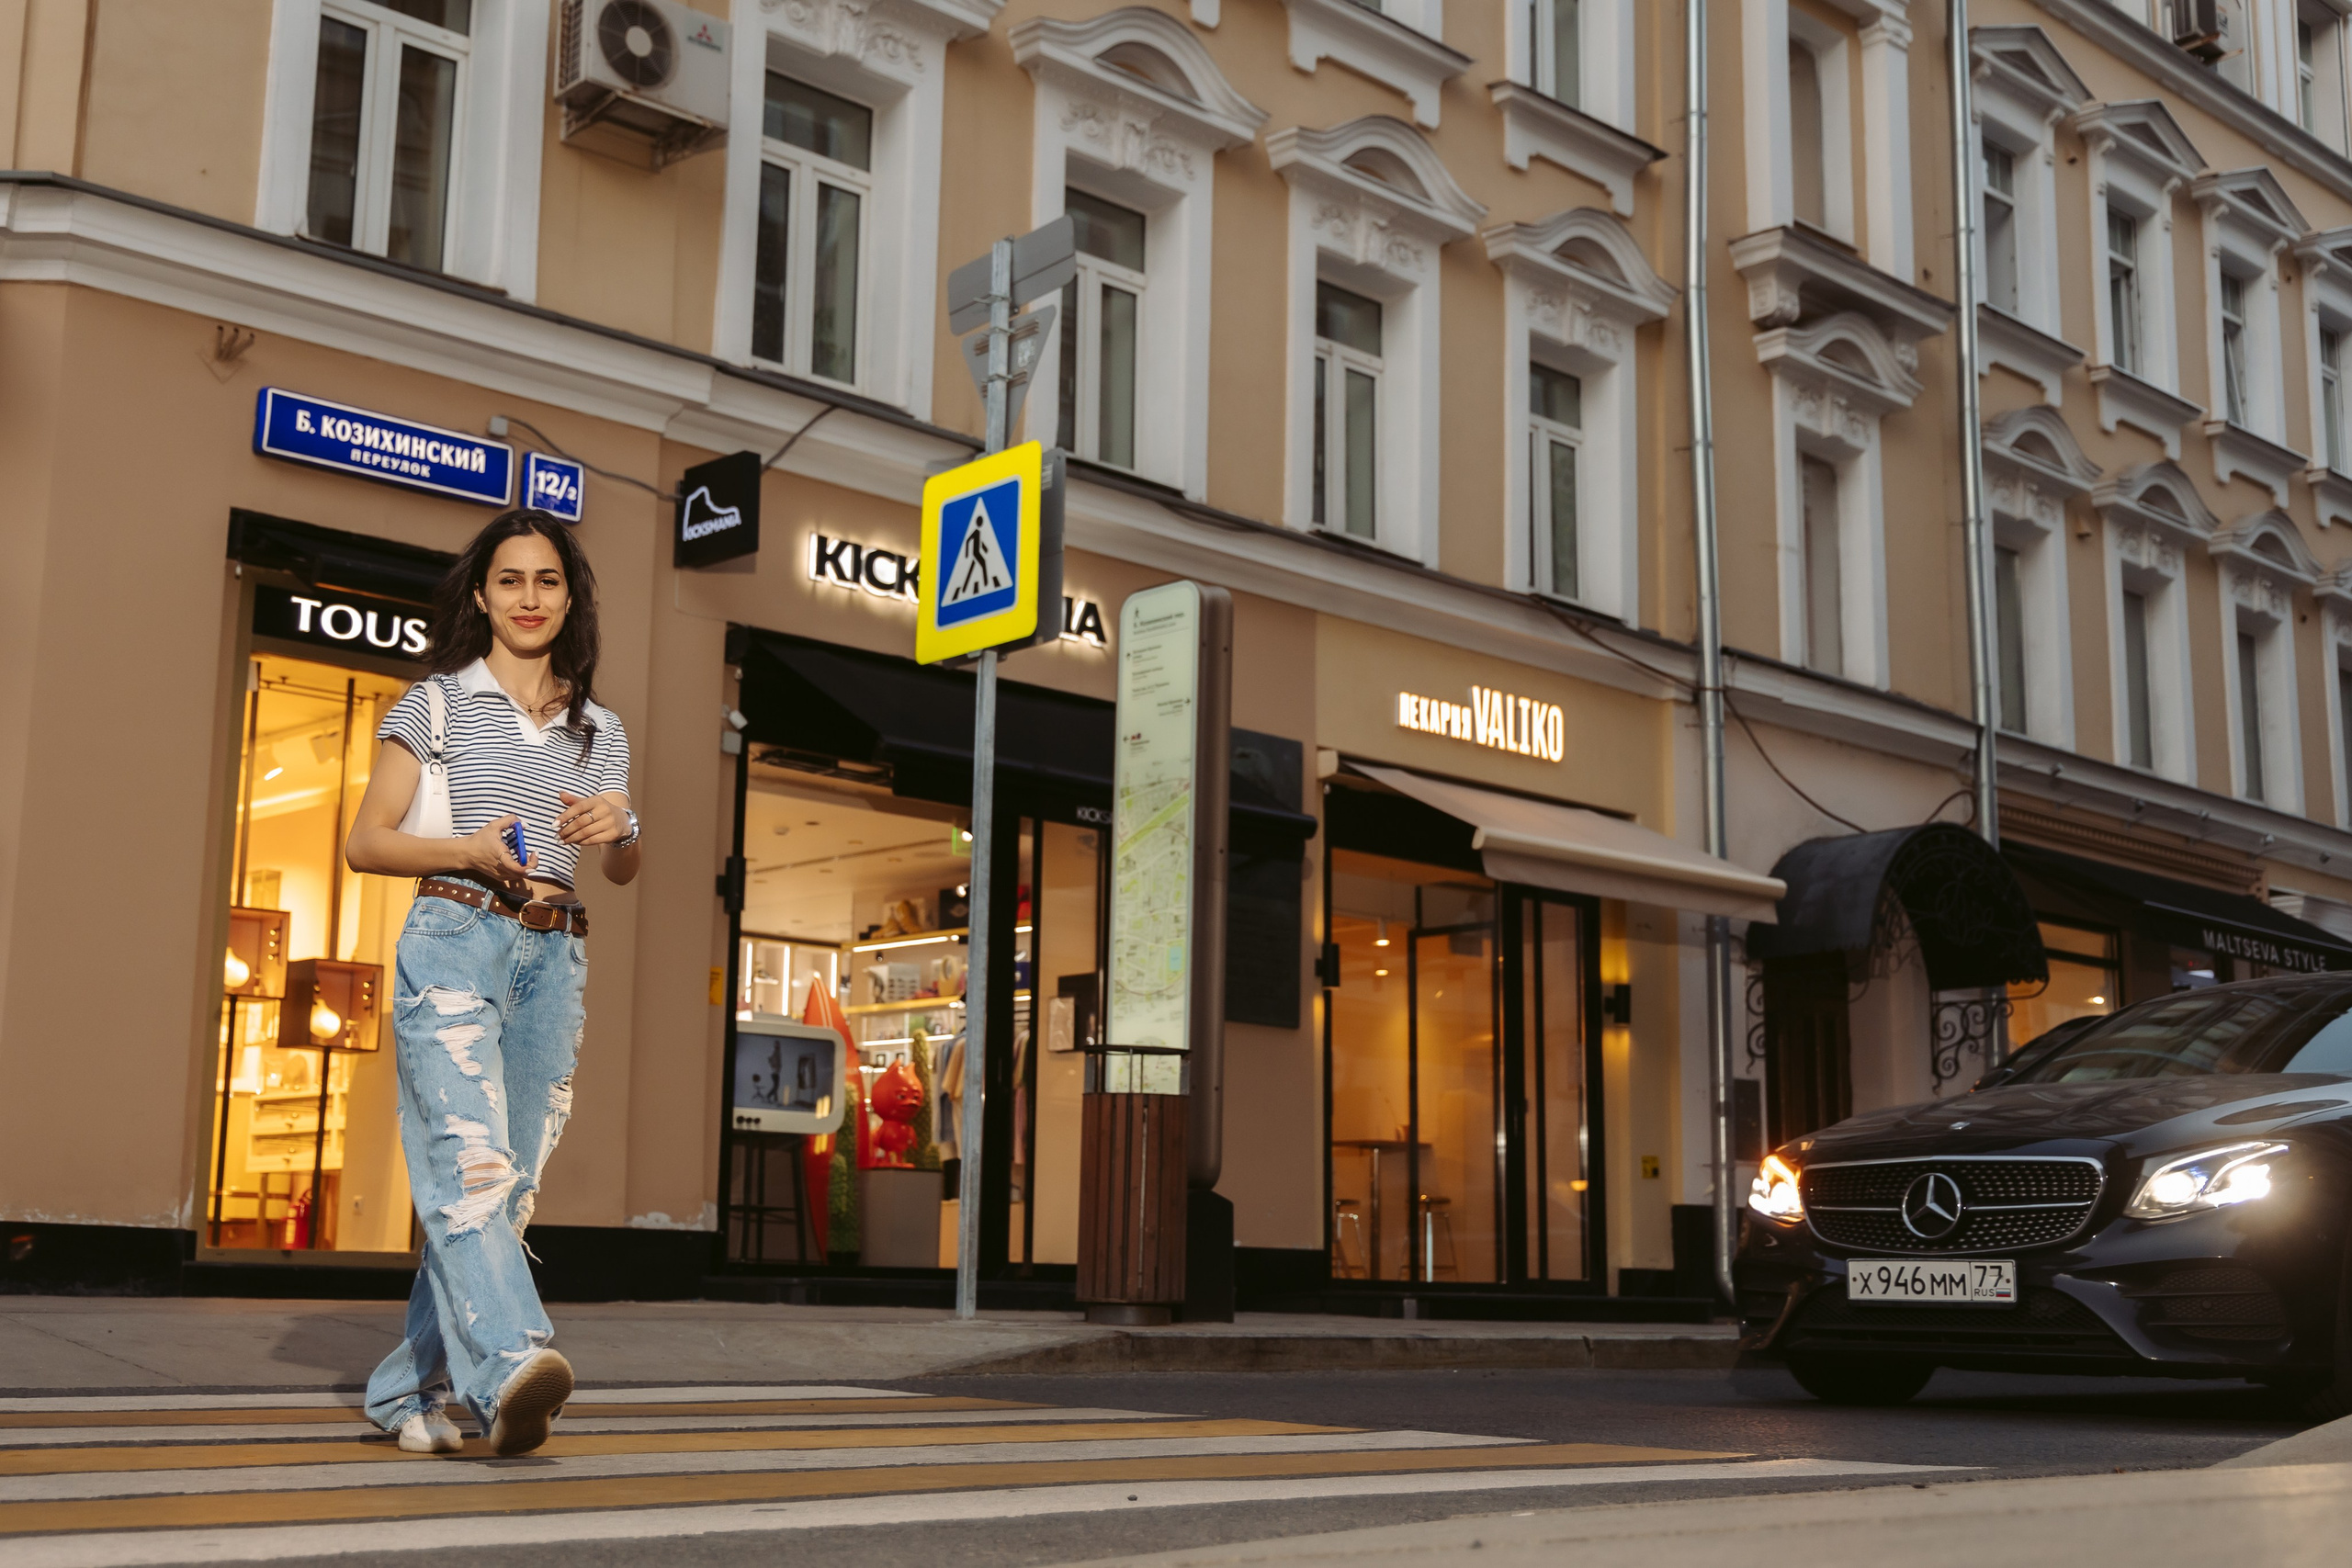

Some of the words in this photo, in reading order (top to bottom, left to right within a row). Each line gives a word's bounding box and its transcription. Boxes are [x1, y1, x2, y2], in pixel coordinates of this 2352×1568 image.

[295, 409, 316, 434] Б.
[320, 415, 487, 474] КОЗИХИНСКИЙ
[350, 448, 431, 479] ПЕРЕУЛОК
[536, 469, 578, 502] 12/2
[290, 595, 428, 654] TOUS
[1472, 684, 1565, 763] VALIKO
[2202, 929, 2280, 964] MALTSEVA
[2283, 947, 2327, 973] STYLE
[1973, 1265, 2004, 1288] 77
[1973, 1288, 1996, 1297] RUS
